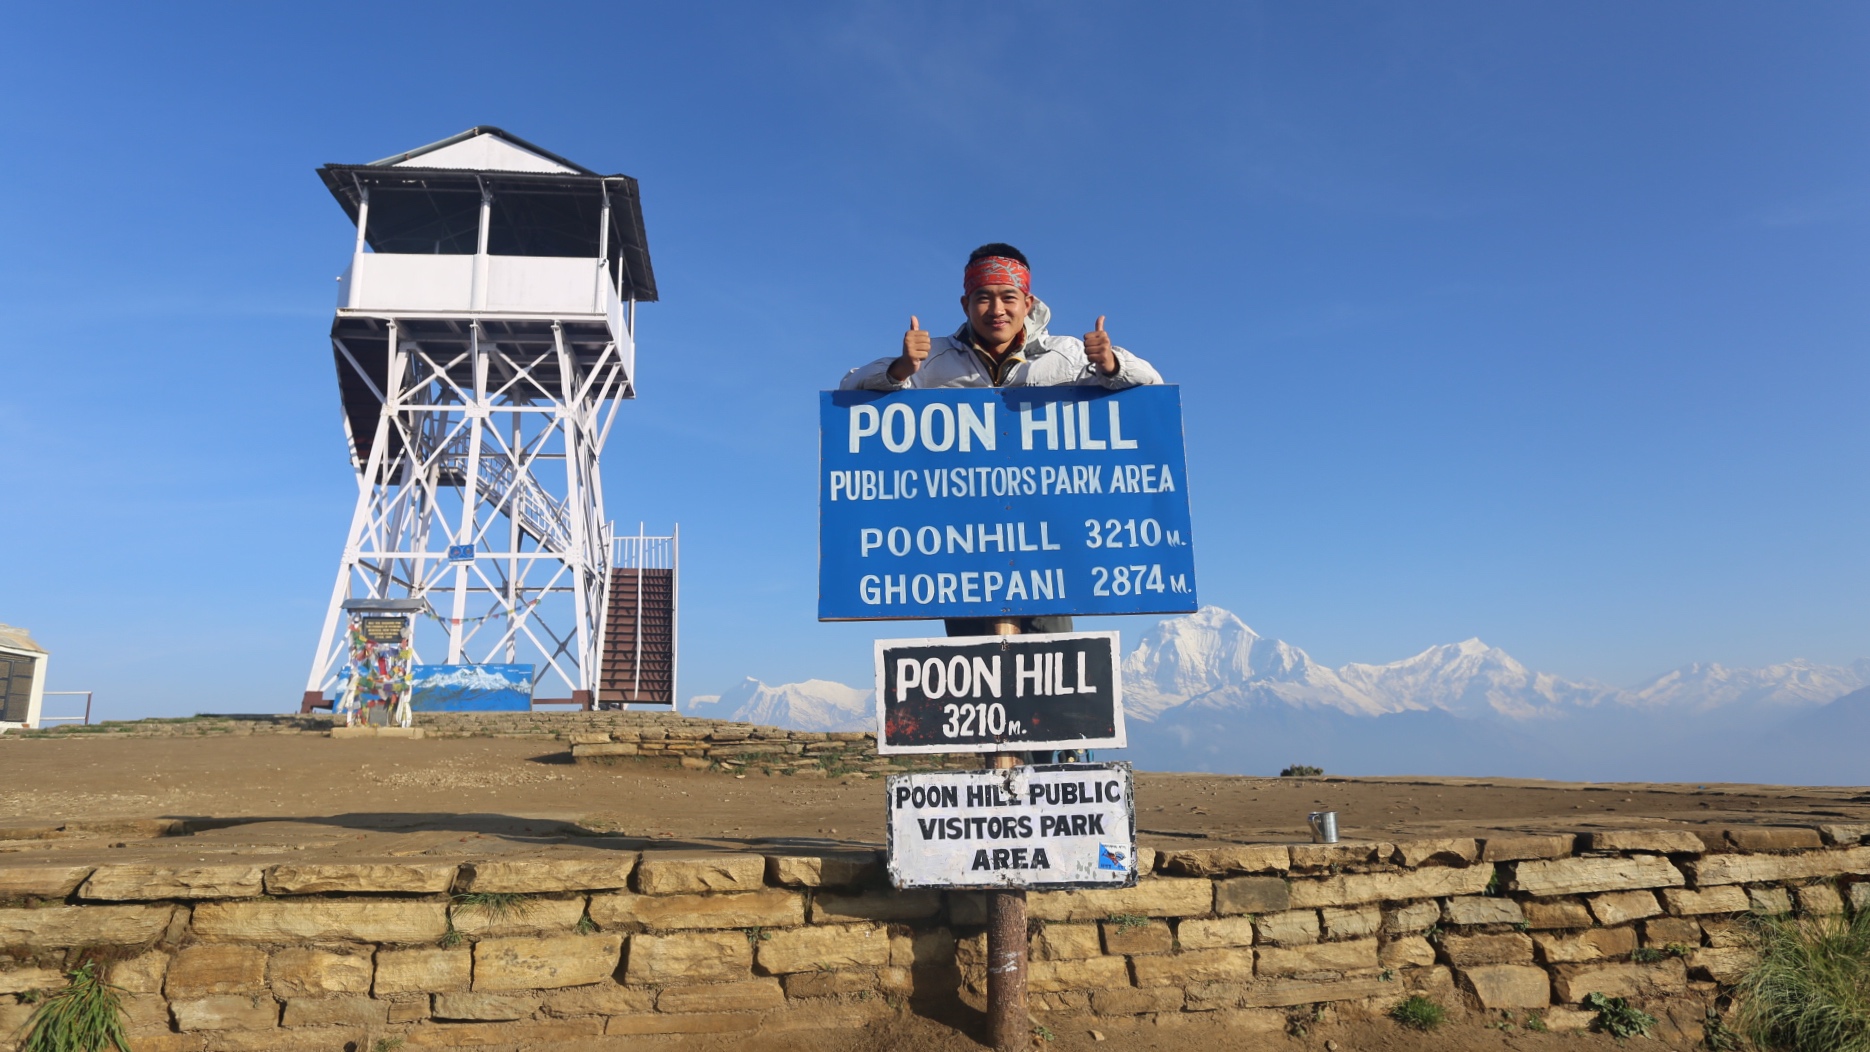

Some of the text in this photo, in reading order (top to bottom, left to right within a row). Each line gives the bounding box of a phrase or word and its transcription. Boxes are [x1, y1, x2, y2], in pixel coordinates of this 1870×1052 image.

[849, 401, 1138, 453] POON HILL
[831, 465, 1174, 500] PUBLIC VISITORS PARK AREA
[861, 522, 1060, 557] POONHILL
[1085, 519, 1161, 548] 3210
[860, 569, 1065, 604] GHOREPANI
[1092, 565, 1164, 596] 2874
[897, 651, 1096, 704] POON HILL
[943, 703, 1006, 738] 3210
[897, 785, 958, 809] POON
[1028, 781, 1120, 805] PUBLIC
[917, 814, 1104, 840] VISITORS PARK
[972, 848, 1050, 871] AREA
